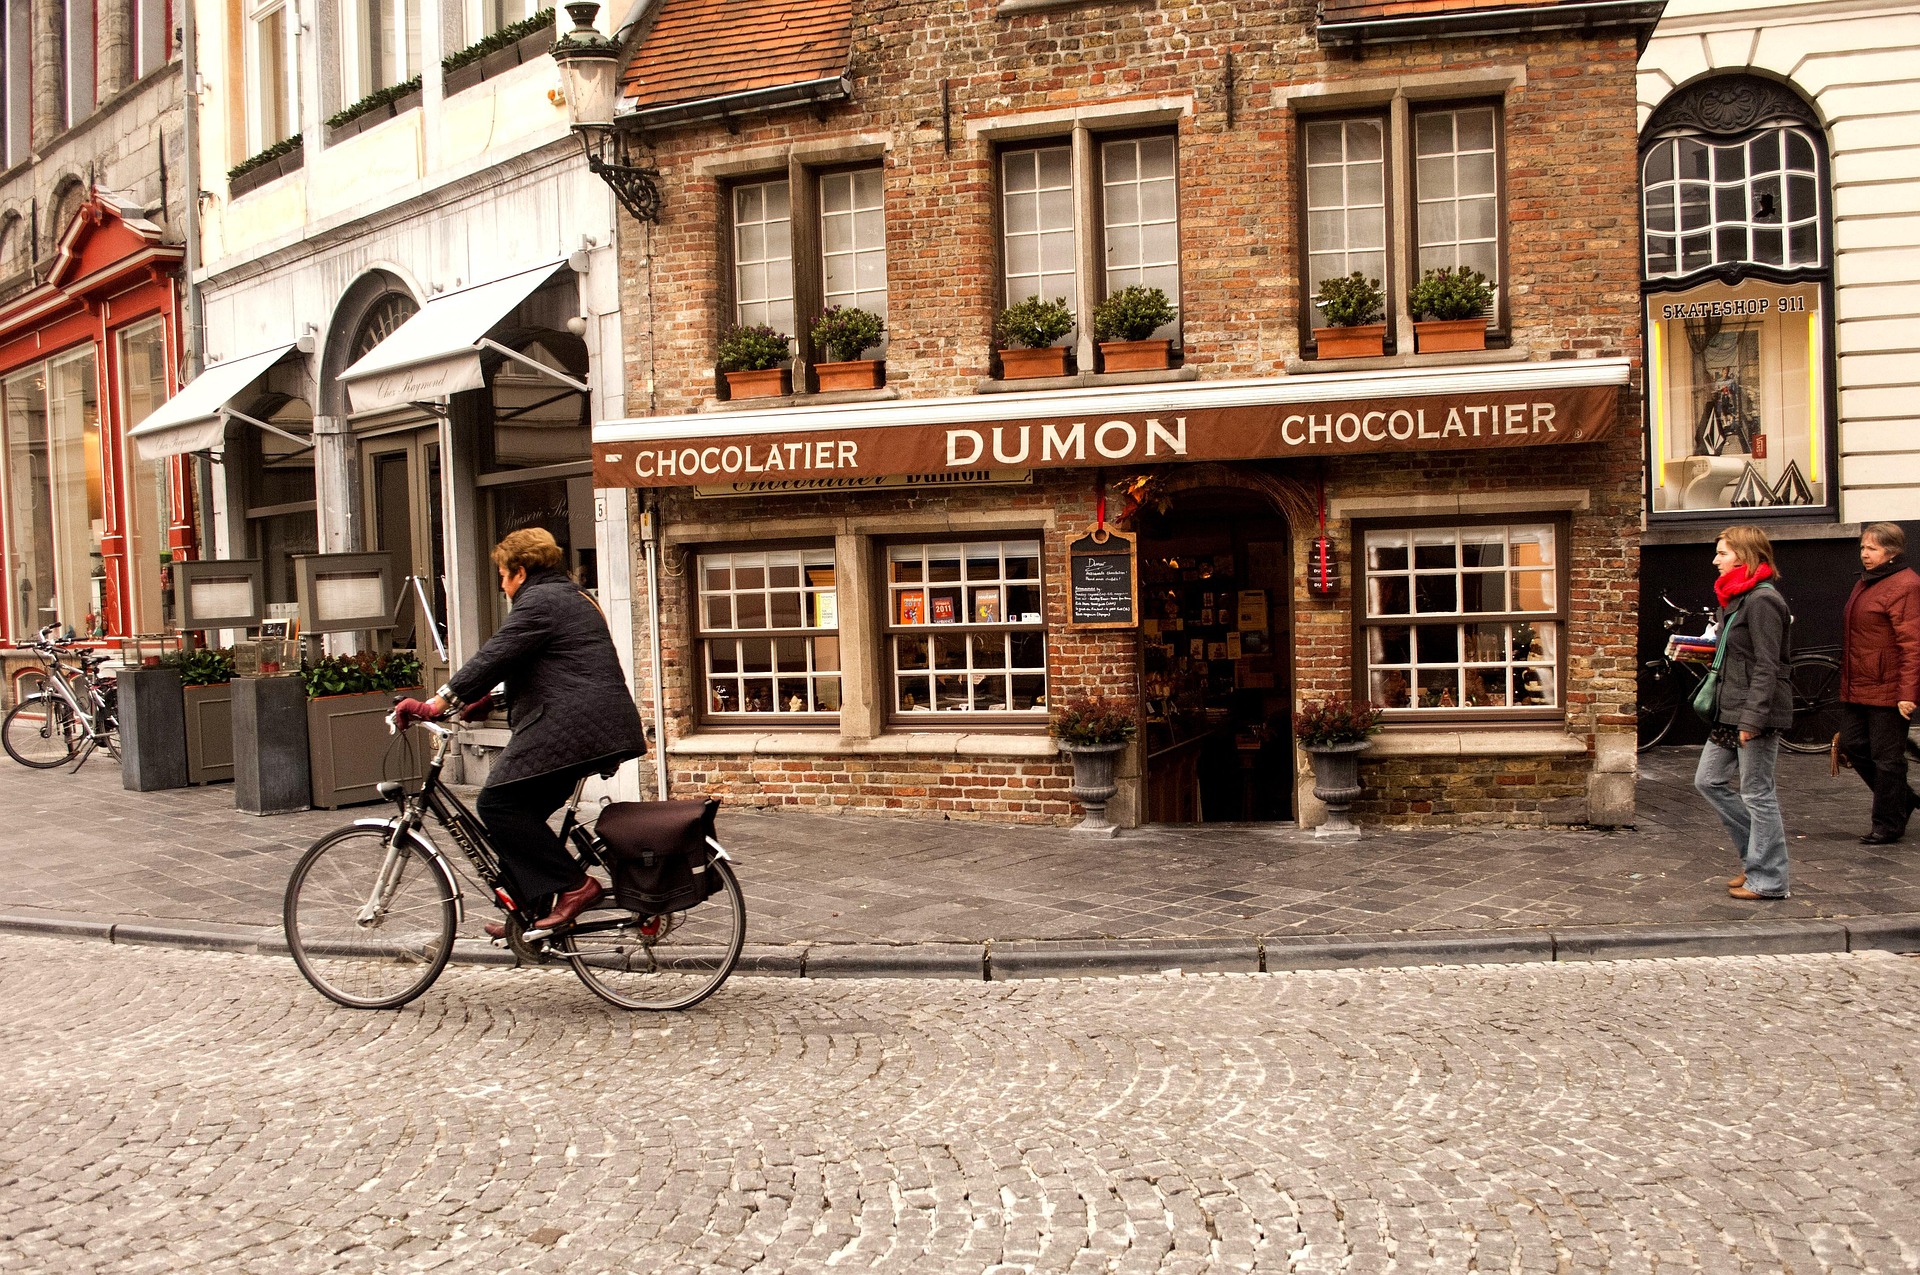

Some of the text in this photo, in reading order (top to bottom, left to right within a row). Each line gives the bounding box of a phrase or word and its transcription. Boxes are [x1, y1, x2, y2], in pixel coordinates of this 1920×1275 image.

[1662, 296, 1804, 319] SKATESHOP 911
[400, 369, 448, 398] Raymond
[1281, 402, 1557, 446] CHOCOLATIER
[945, 416, 1188, 466] DUMON
[636, 440, 859, 477] CHOCOLATIER
[598, 503, 604, 518] 5
[935, 605, 952, 613] 2011
